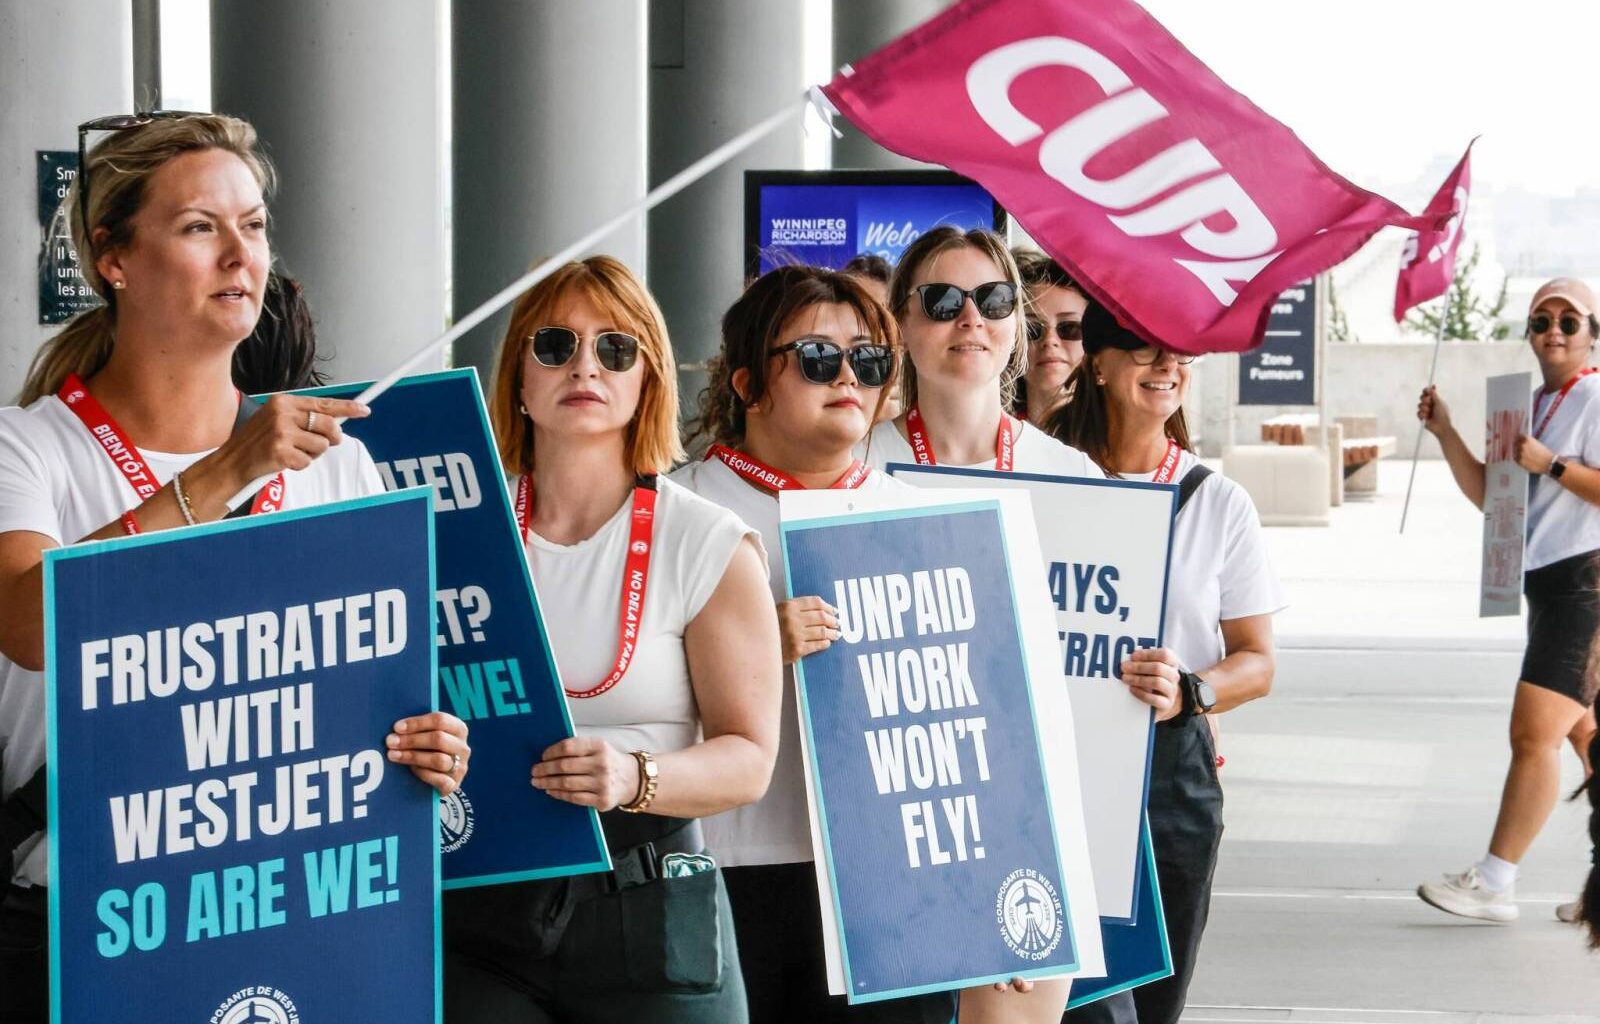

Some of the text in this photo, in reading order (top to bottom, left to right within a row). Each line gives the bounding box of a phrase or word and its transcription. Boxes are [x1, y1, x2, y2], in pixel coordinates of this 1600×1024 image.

[771, 218, 847, 230] WINNIPEG
[771, 230, 847, 240] RICHARDSON
[93, 423, 148, 487] BIENTÔT
[729, 454, 787, 488] ÉQUITABLE
[913, 431, 926, 452] PAS
[630, 569, 643, 590] NO
[834, 566, 976, 644] UNPAID
[81, 588, 408, 710] FRUSTRATED
[857, 642, 980, 718] WORK
[1057, 630, 1157, 680] RAC
[439, 658, 532, 721] WE!
[180, 682, 315, 772] WITH
[864, 716, 990, 795] WON'T
[109, 749, 385, 864] WESTJET?
[900, 795, 986, 868] FLY!
[96, 835, 400, 959] SO ARE WE!
[996, 868, 1025, 924] COMPOSANTE
[1025, 868, 1037, 879] DE
[1038, 873, 1063, 916] WESTJET
[1031, 917, 1064, 961] COMPONENT
[256, 985, 273, 996] DE
